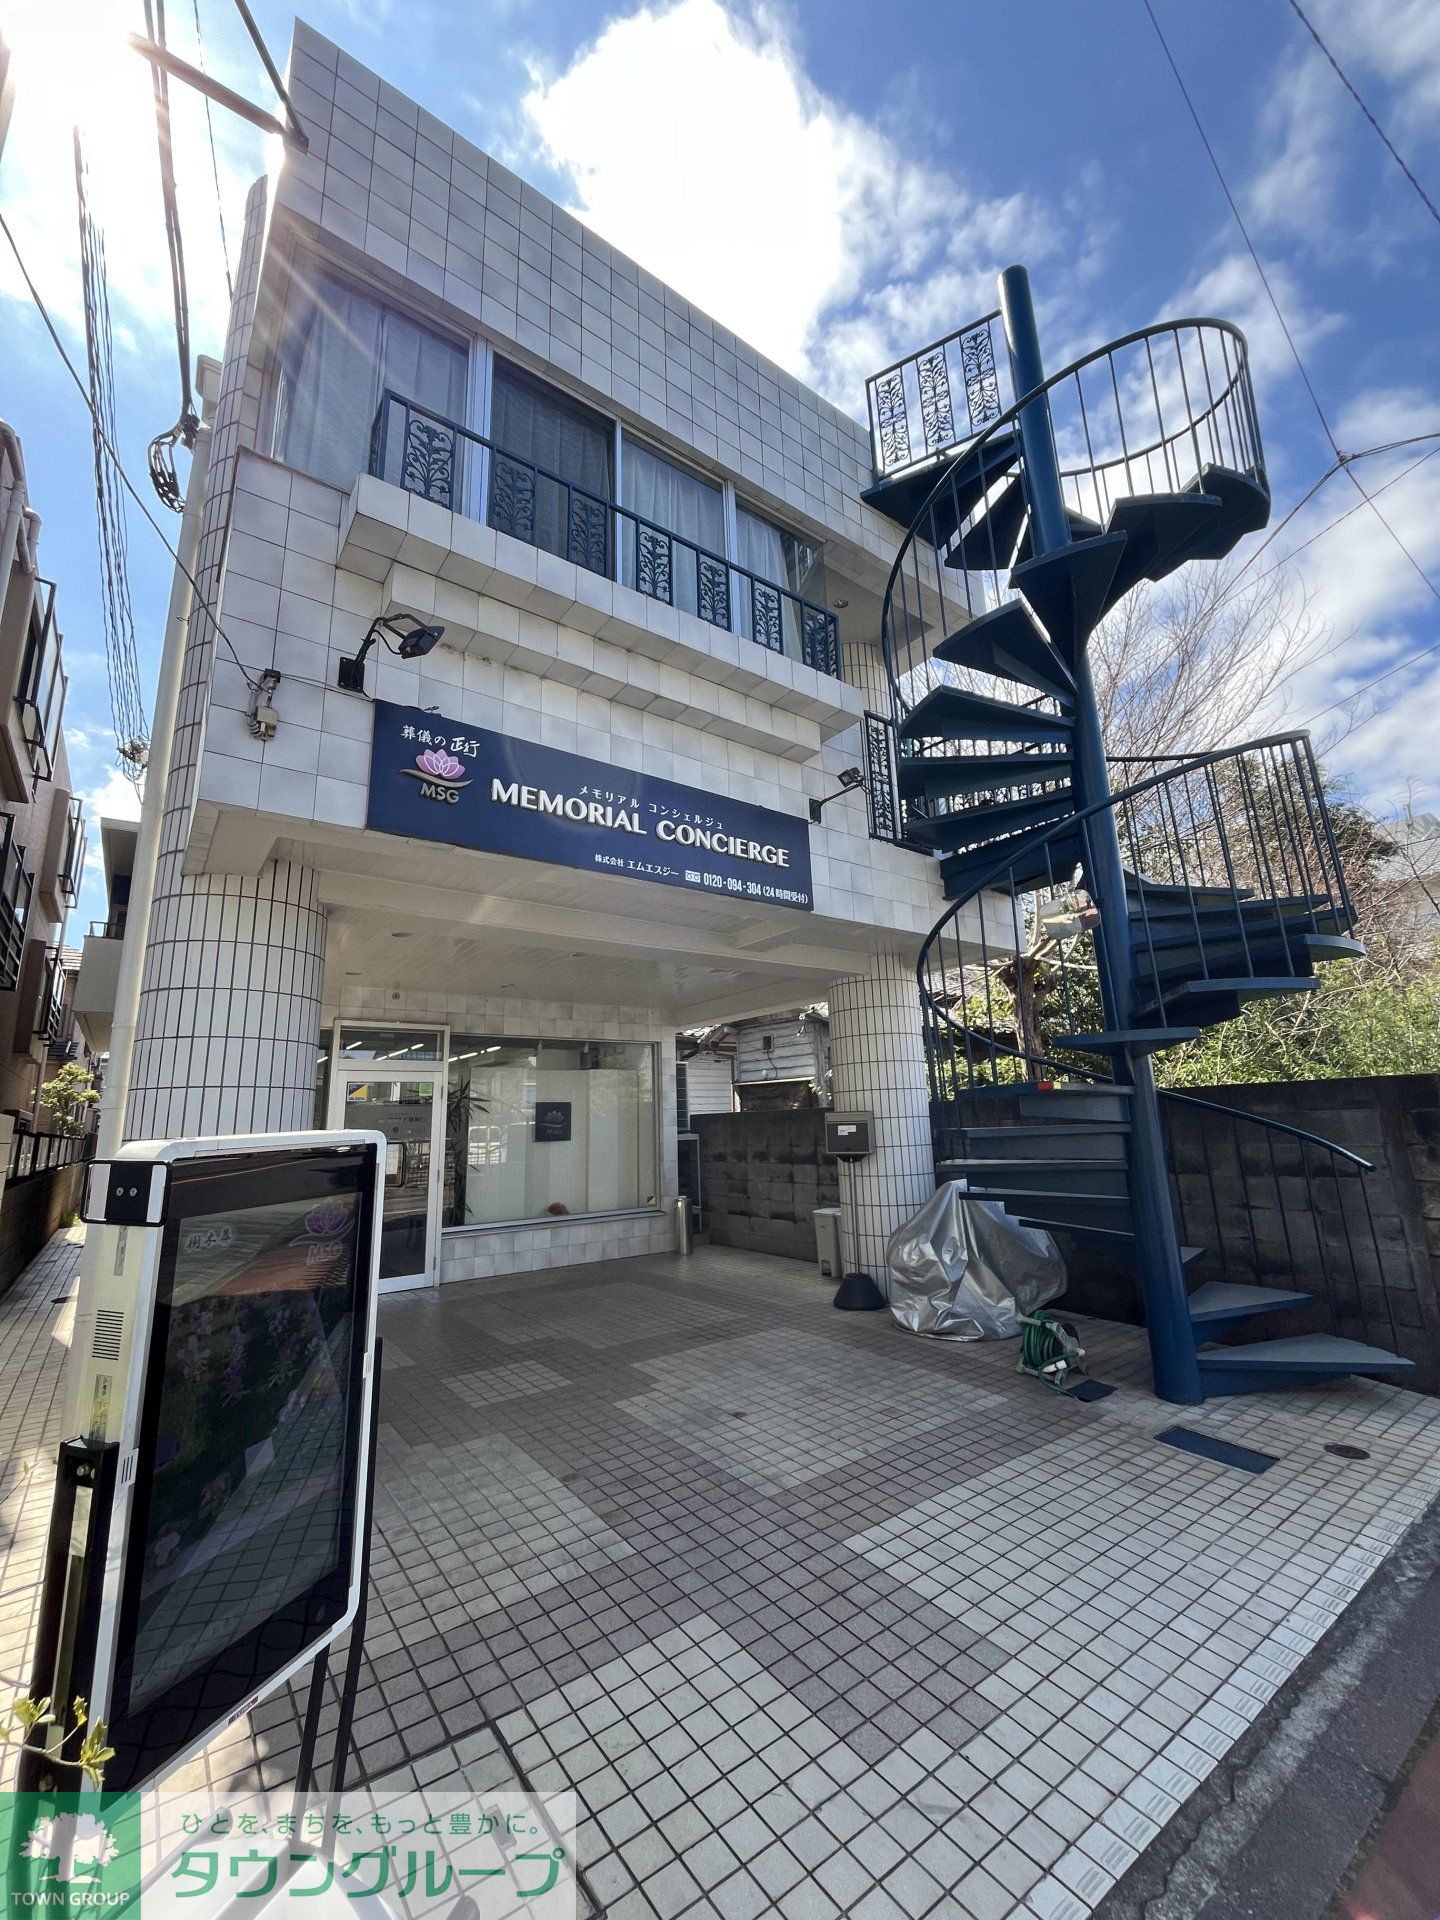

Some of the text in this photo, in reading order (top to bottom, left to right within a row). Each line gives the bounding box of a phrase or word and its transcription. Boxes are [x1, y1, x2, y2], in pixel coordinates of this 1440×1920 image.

[420, 782, 460, 804] MSG
[579, 785, 724, 830] メモリアル コンシェルジュ
[491, 778, 790, 868] MEMORIAL CONCIERGE
[594, 853, 680, 876] 株式会社 エムエスジー
[703, 872, 762, 896] 0120-094-304
